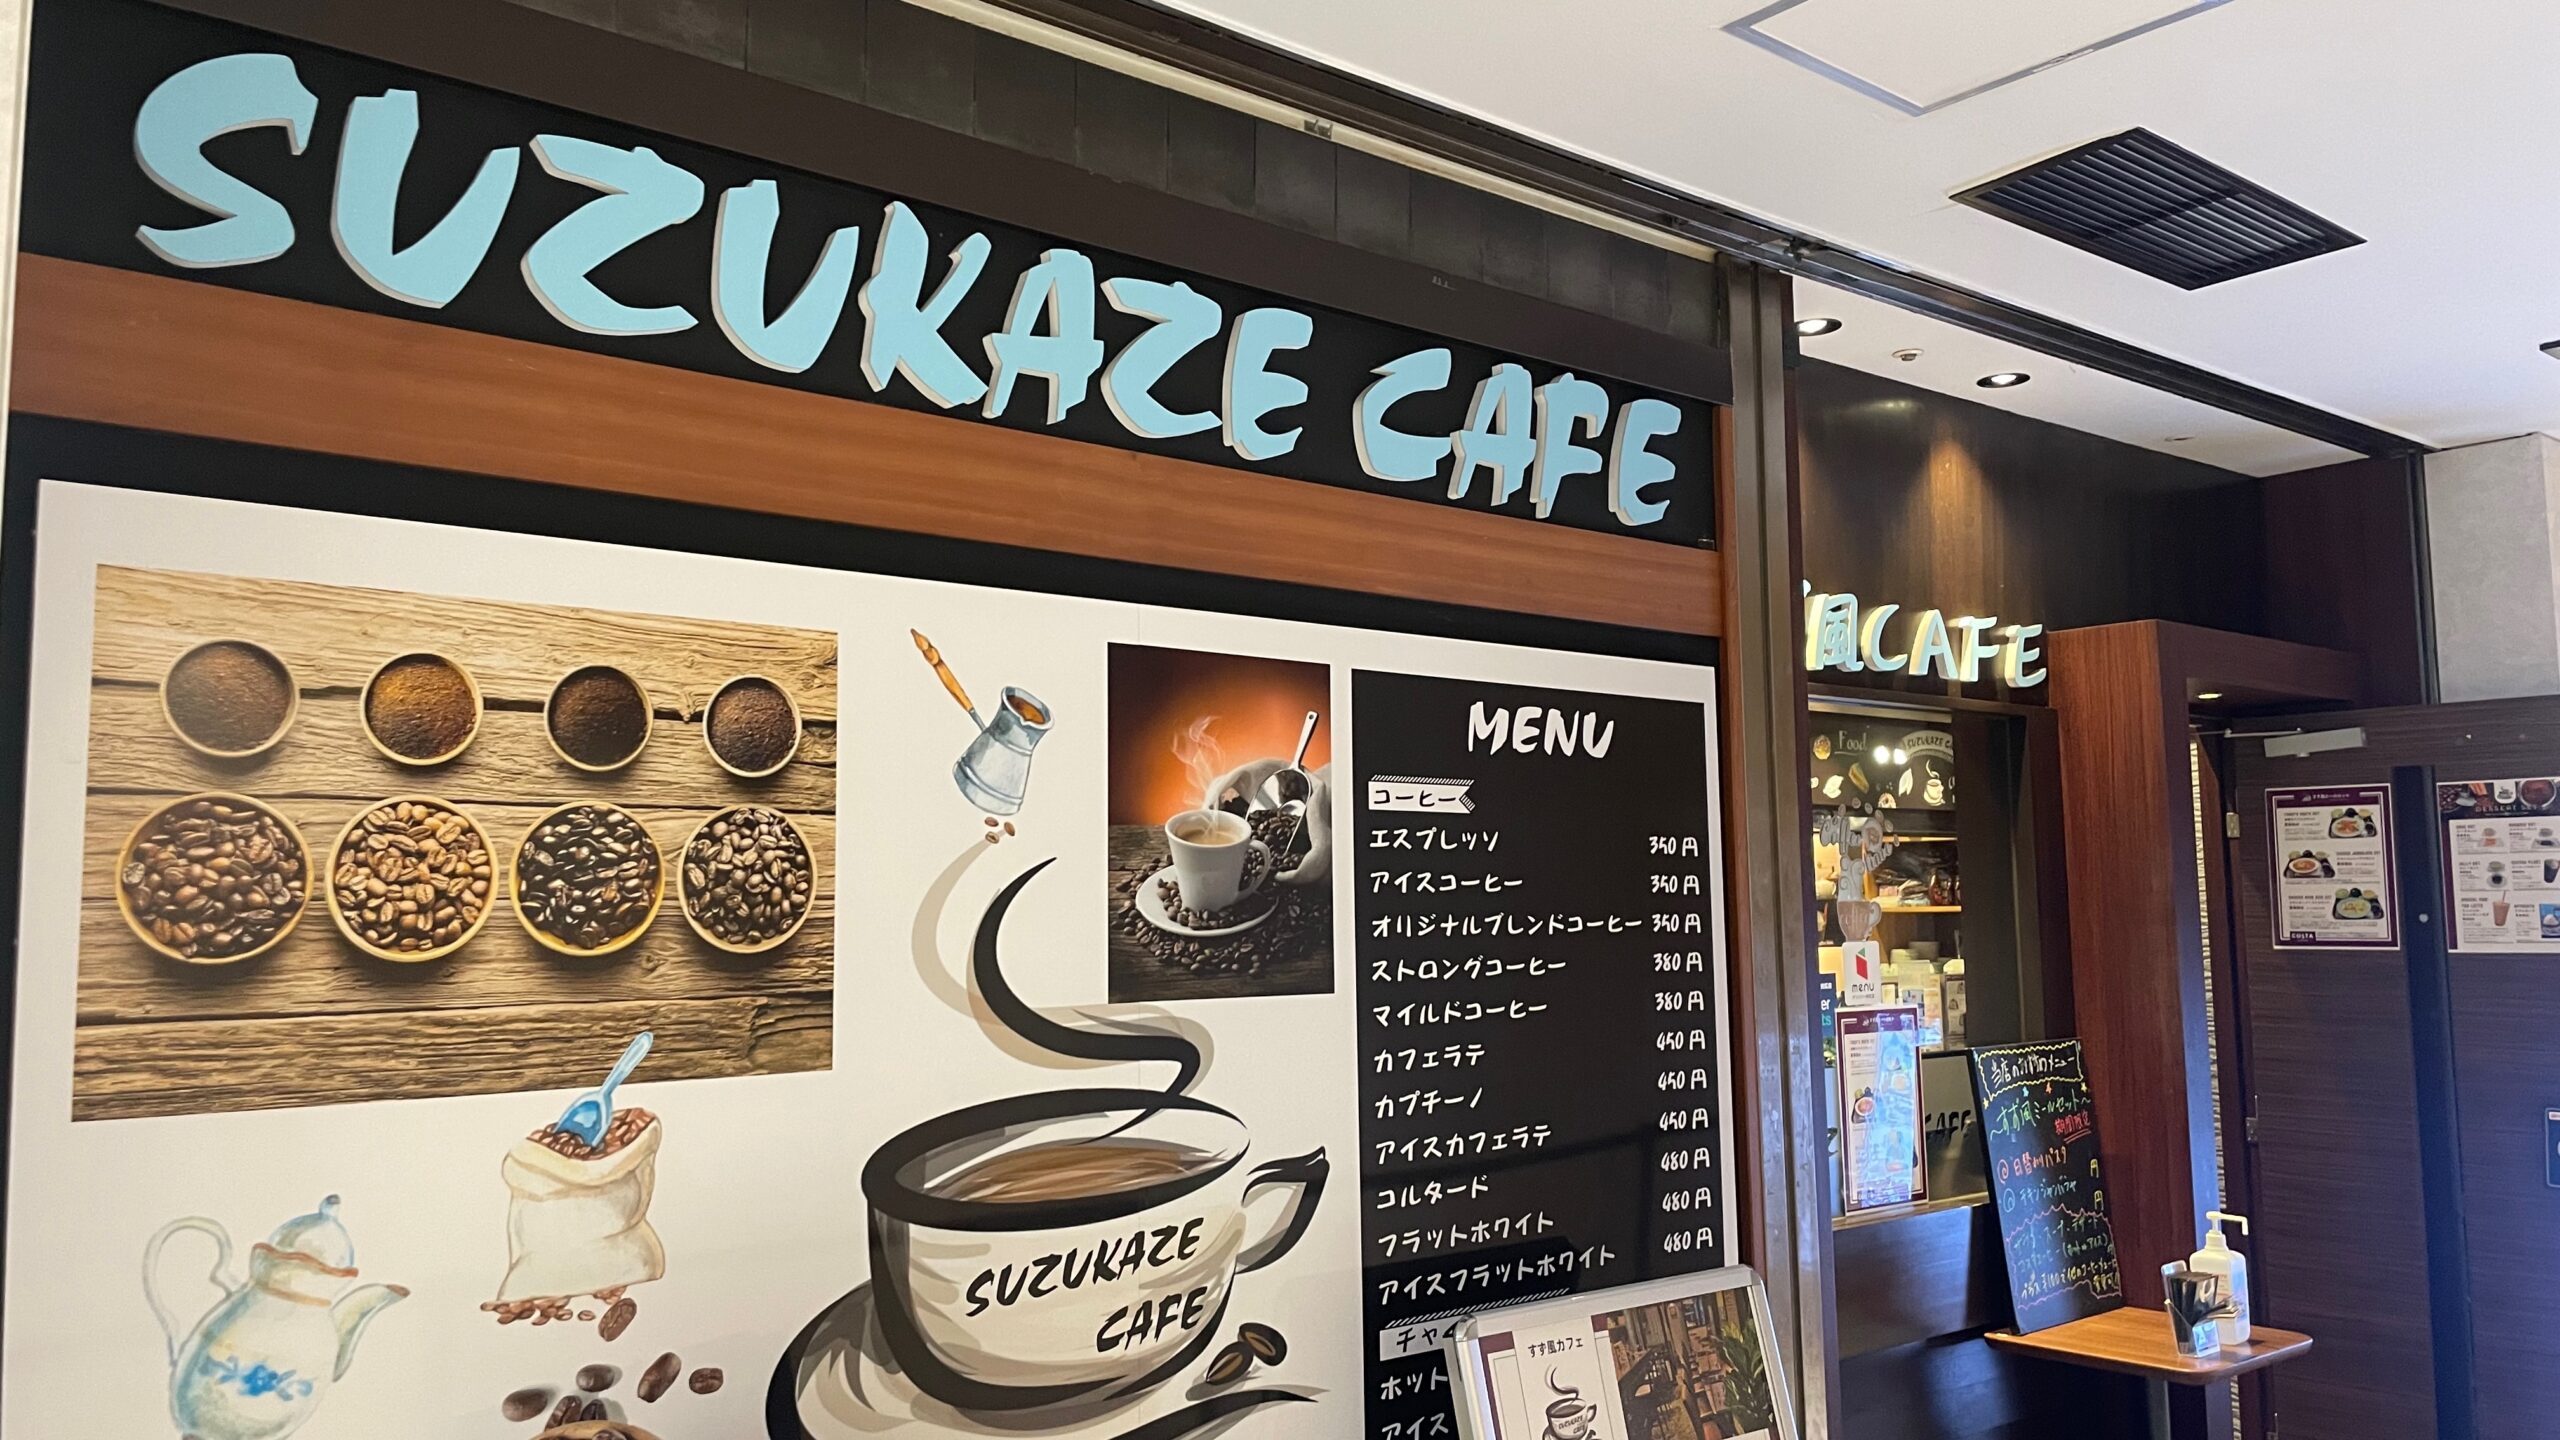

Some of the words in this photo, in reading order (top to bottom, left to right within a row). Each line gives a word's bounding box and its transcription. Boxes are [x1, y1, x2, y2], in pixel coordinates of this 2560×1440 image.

[133, 53, 1314, 461] SUZUKAZE
[1352, 347, 1682, 526] CAFE
[1803, 579, 2047, 688] 風CAFE
[1467, 701, 1615, 759] MENU
[1838, 730, 1867, 751] Food
[1373, 790, 1457, 808] コーヒー
[1369, 827, 1500, 852] エスプレッソ
[1648, 836, 1699, 858] 350円
[1369, 871, 1523, 895] アイスコーヒー
[1650, 874, 1700, 896] 350円
[1371, 911, 1643, 939] オリジナルブレンドコーヒー
[1652, 913, 1702, 935] 350円
[1371, 954, 1567, 983] ストロングコーヒー
[1653, 951, 1704, 973] 380円
[1821, 999, 1831, 1011] er
[1852, 983, 1875, 993] menu
[1373, 1000, 1548, 1028] マイルドコーヒー
[1654, 990, 1705, 1012] 380円
[1822, 1014, 1832, 1026] ts
[1374, 1043, 1486, 1073] カフェラテ
[1656, 1029, 1707, 1051] 450円
[1375, 1087, 1485, 1119] カプチーノ
[1657, 1068, 1708, 1091] 450円
[1375, 1124, 1552, 1165] アイスカフェラテ
[1659, 1107, 1709, 1131] 450円
[1376, 1175, 1489, 1210] コルタード
[1660, 1147, 1710, 1171] 480円
[1378, 1211, 1555, 1258] フラットホワイト
[1662, 1186, 1712, 1212] 480円
[965, 1217, 1204, 1316] SUZUKAZE
[1378, 1244, 1616, 1306] アイスフラットホワイト
[1663, 1227, 1714, 1253] 480円
[1096, 1286, 1207, 1352] CAFE
[1528, 1337, 1584, 1358] すず風カフェ
